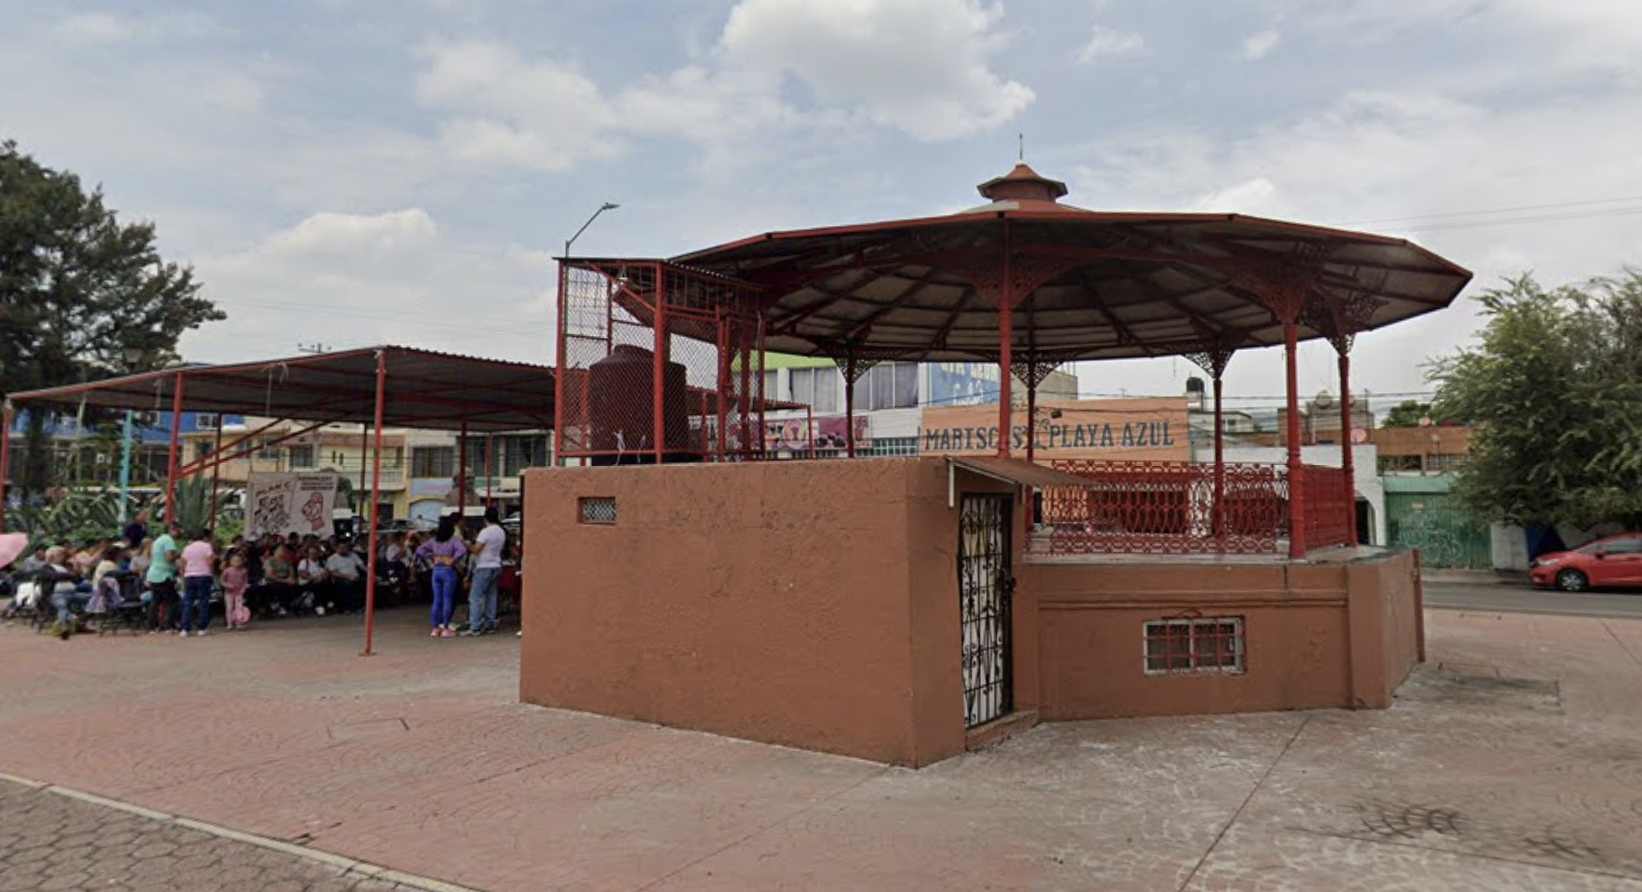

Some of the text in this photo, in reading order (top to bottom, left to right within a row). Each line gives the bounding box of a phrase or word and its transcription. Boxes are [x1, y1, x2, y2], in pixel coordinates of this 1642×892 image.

[925, 420, 1174, 450] MARISCS PLAYA AZUL
